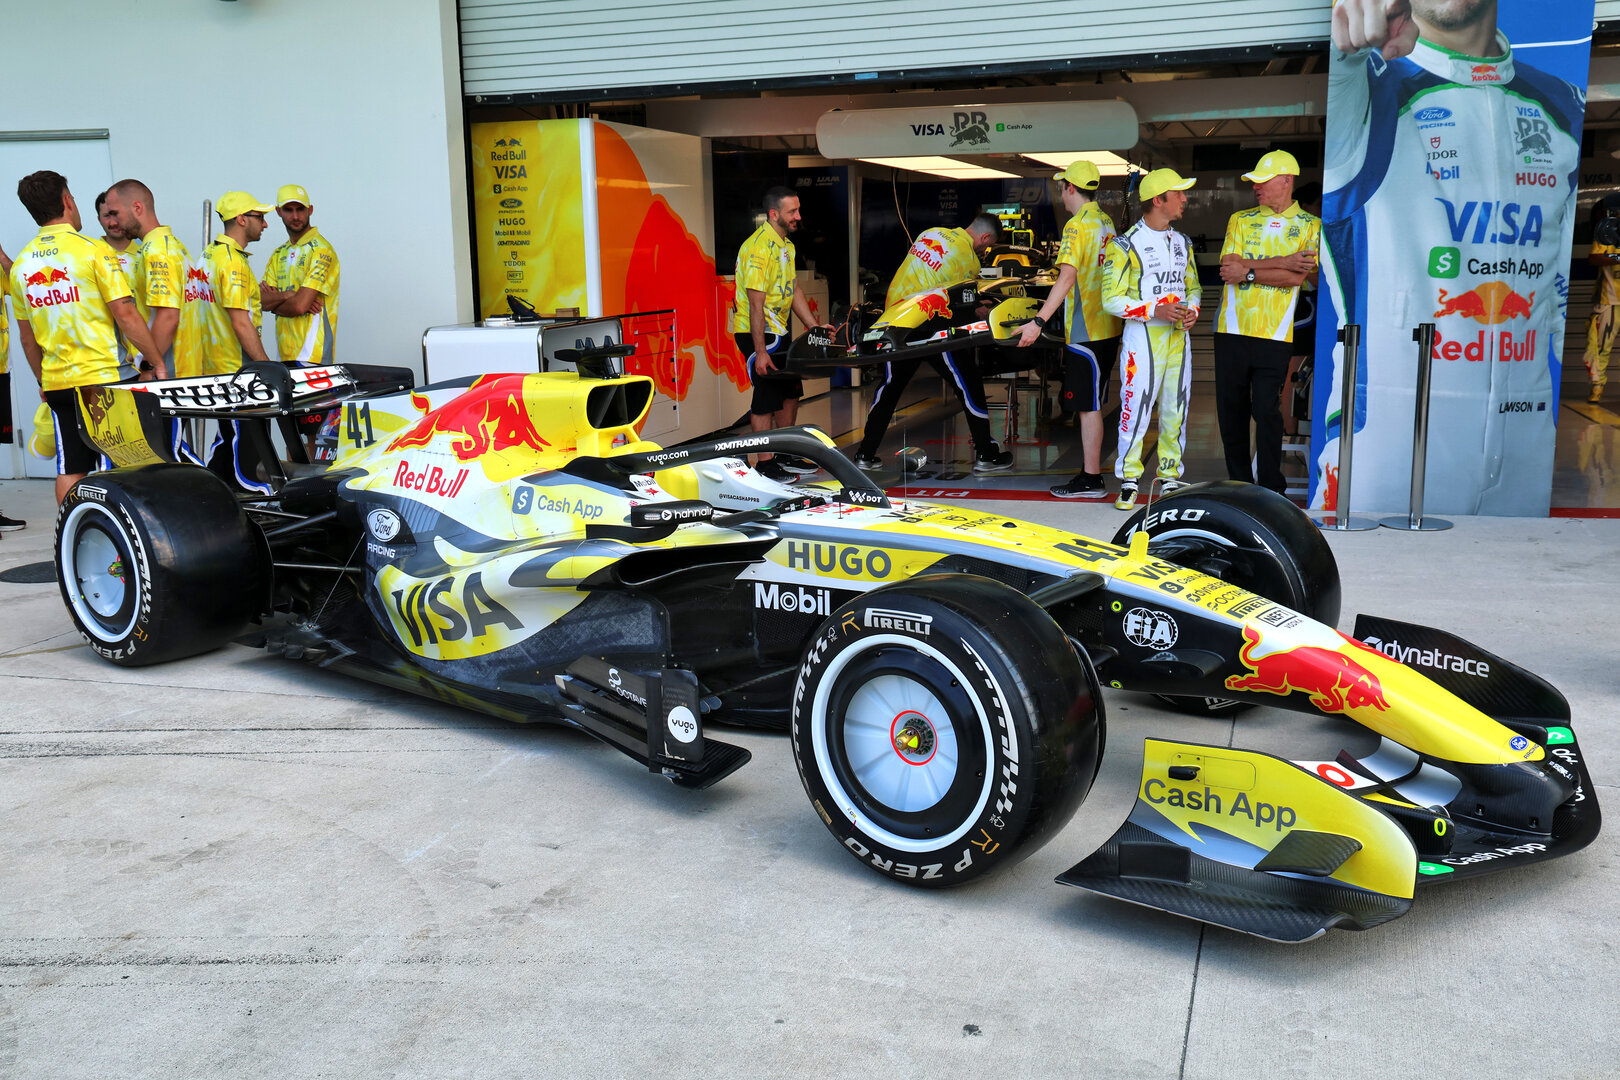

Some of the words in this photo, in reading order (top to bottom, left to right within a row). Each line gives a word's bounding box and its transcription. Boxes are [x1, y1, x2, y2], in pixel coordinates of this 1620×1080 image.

[1421, 109, 1444, 120] Ford
[1515, 106, 1541, 118] VISA
[910, 124, 945, 136] VISA
[491, 150, 508, 160] Red
[510, 150, 526, 160] Bull
[492, 165, 527, 179] VISA
[1516, 172, 1557, 188] HUGO
[499, 218, 526, 226] HUGO
[1434, 198, 1543, 248] VISA
[938, 232, 956, 243] HUGO
[32, 248, 58, 258] HUGO
[910, 245, 922, 259] Red
[922, 252, 942, 272] Bull
[1154, 271, 1182, 284] VISA
[1518, 259, 1544, 279] App
[26, 290, 54, 308] Red
[53, 286, 80, 305] Bull
[1432, 330, 1485, 362] Red
[1498, 330, 1536, 362] Bull
[1122, 390, 1134, 413] Red
[1499, 402, 1533, 414] LAWSON
[347, 402, 378, 448] 41
[1121, 411, 1131, 432] Bull
[106, 426, 125, 446] Bull
[717, 437, 769, 450] XMTRADING
[315, 446, 337, 460] Mobil
[646, 450, 689, 466] yugo.com
[724, 460, 745, 470] Mobil
[393, 461, 430, 490] Red
[426, 466, 469, 498] Bull
[634, 478, 656, 487] Mobil
[77, 484, 108, 502] PIRELLI
[719, 493, 760, 503] @VISACASHAPPRB
[538, 494, 571, 514] Cash
[571, 499, 603, 520] App
[674, 507, 714, 520] hahnair
[375, 513, 394, 536] Ford
[367, 542, 396, 558] RACING
[788, 540, 892, 579] HUGO
[1053, 538, 1130, 562] 41
[754, 582, 831, 616] Mobil
[392, 572, 525, 647] VISA
[1263, 610, 1290, 623] NEFT
[864, 608, 934, 636] PIRELLI
[81, 631, 124, 660] ZERO
[126, 640, 137, 656] P
[1384, 640, 1490, 678] dynatrace
[616, 686, 648, 708] OCTAVE
[672, 719, 694, 734] yugo
[1144, 778, 1221, 814] Cash
[1230, 792, 1296, 832] App
[844, 837, 944, 880] ZERO
[954, 848, 973, 872] P
[1442, 846, 1502, 866] Cash
[1501, 842, 1546, 857] App
